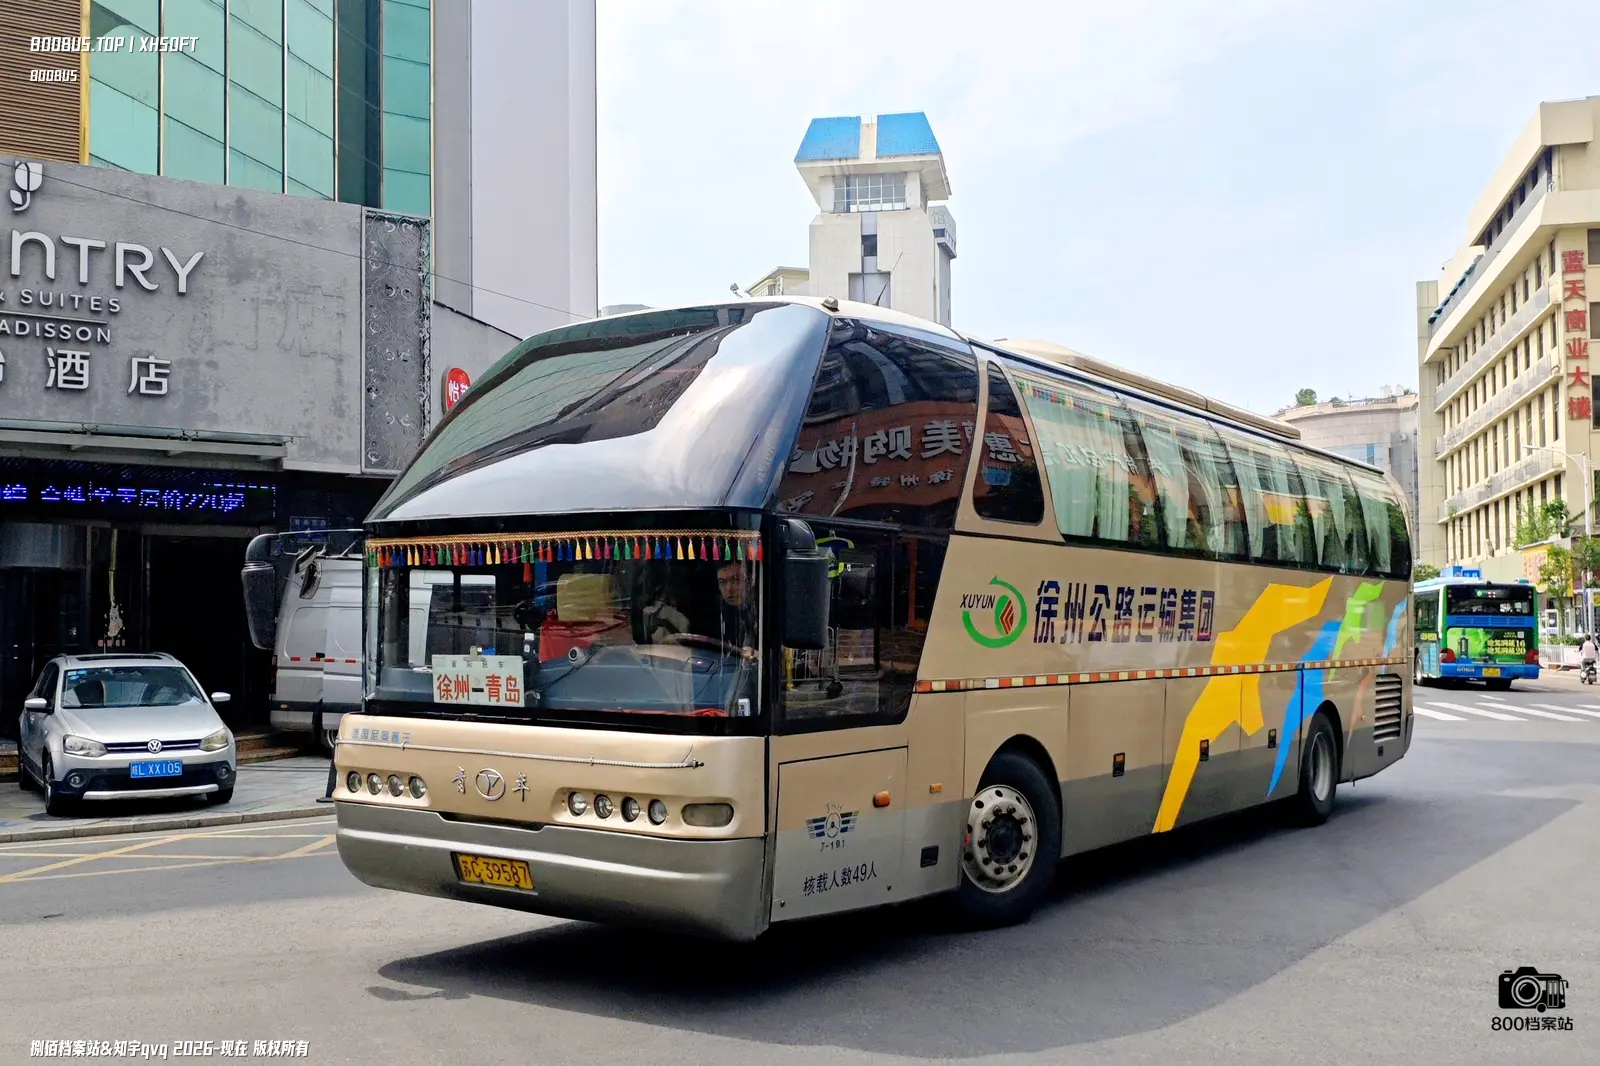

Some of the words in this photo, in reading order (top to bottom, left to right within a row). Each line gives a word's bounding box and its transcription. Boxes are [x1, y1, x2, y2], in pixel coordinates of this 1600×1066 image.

[20, 288, 121, 313] SUITES
[0, 319, 111, 344] ADISSON
[960, 593, 995, 609] XUYUN
[1033, 580, 1215, 644] 徐州公路运输集团
[803, 861, 877, 896] 核载人数49人
